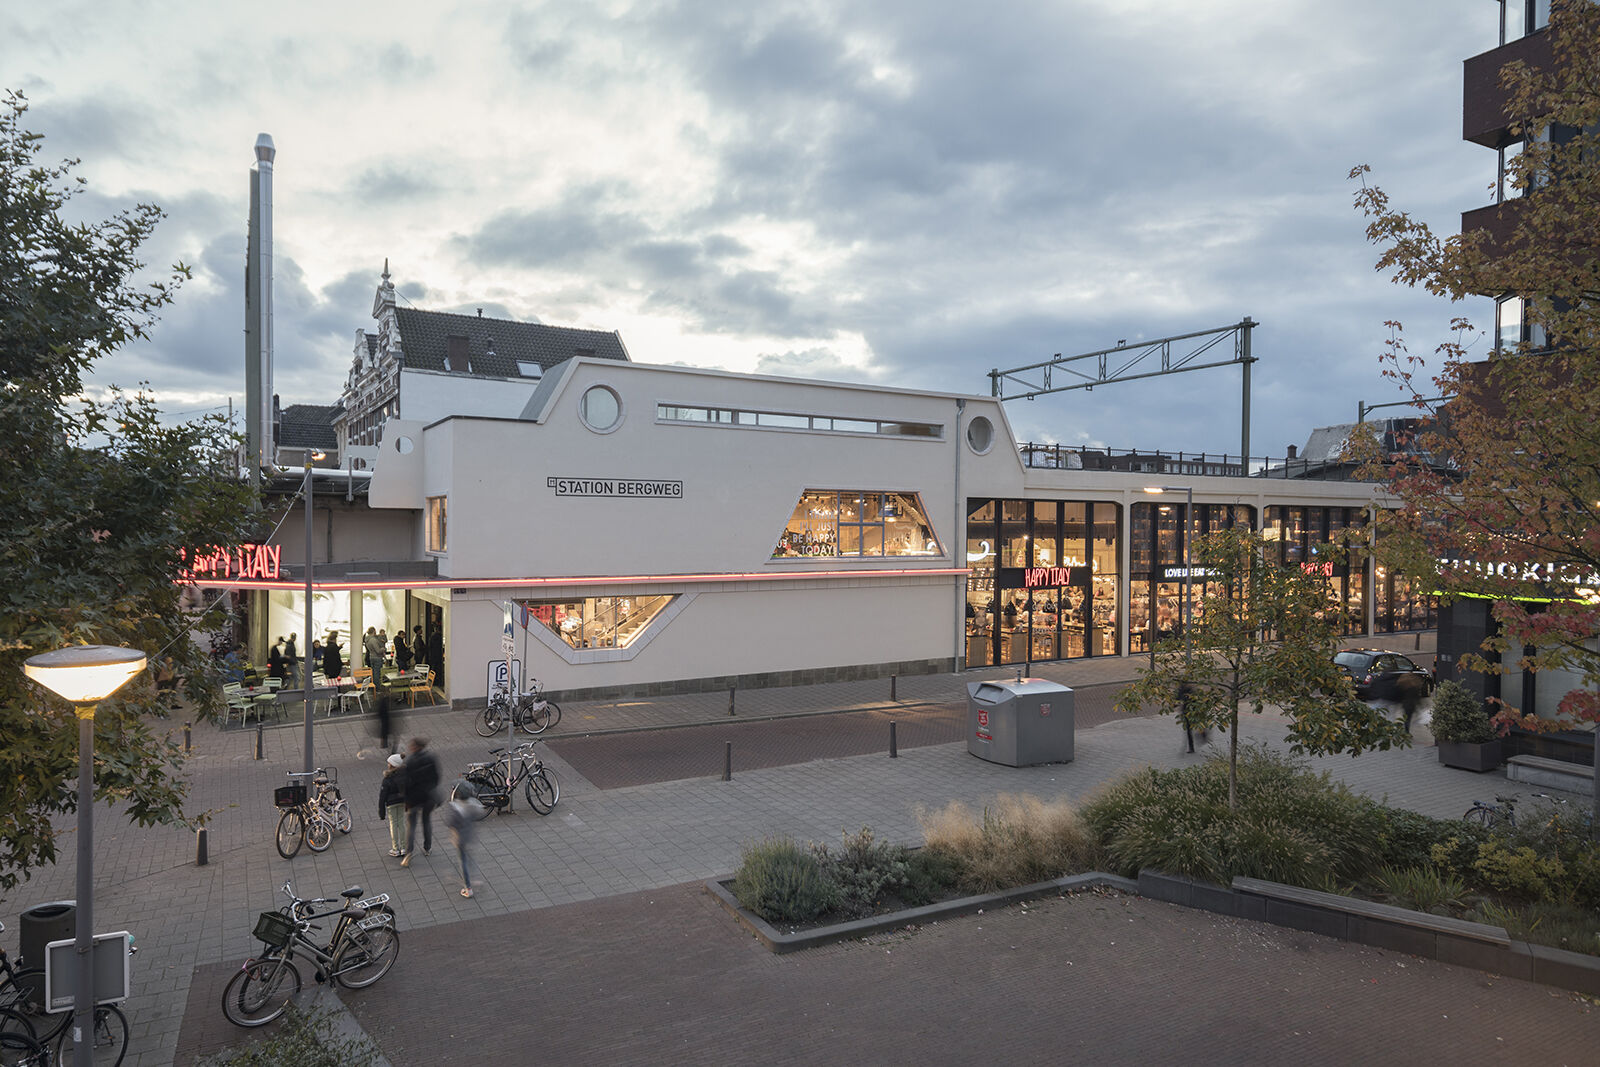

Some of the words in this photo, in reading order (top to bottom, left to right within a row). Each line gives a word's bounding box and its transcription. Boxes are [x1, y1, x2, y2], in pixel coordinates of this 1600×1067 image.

[559, 481, 613, 494] STATION
[618, 483, 680, 495] BERGWEG
[793, 534, 803, 543] BE
[806, 534, 835, 543] HAPPY
[236, 543, 281, 579] ITALY
[1025, 568, 1049, 587] HAPPY
[1050, 567, 1071, 586] ITALY
[1164, 568, 1181, 578] LOVE
[500, 667, 508, 679] P
